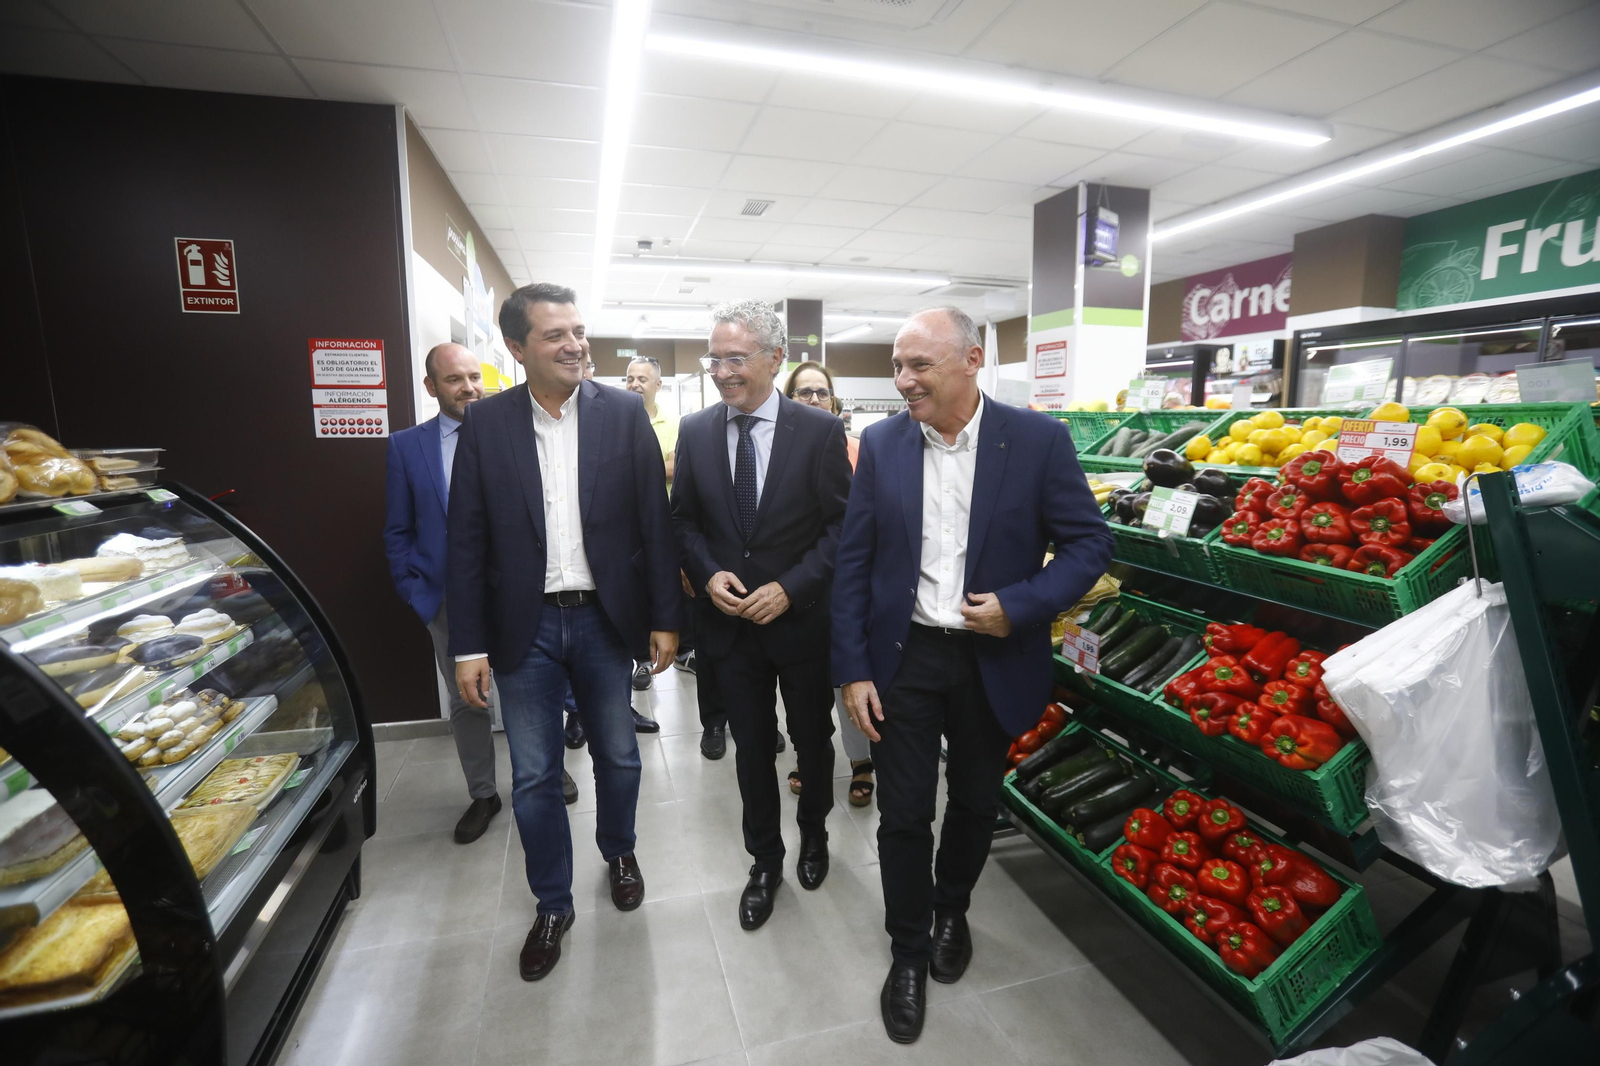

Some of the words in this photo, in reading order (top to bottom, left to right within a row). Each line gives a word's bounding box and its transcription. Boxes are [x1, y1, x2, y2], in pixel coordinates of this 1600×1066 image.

[1480, 216, 1600, 281] Fru
[187, 297, 235, 305] EXTINTOR
[1191, 279, 1292, 325] Carne
[315, 340, 377, 349] INFORMACIÓN
[1343, 420, 1375, 432] OFERTA
[1340, 434, 1366, 444] PRECIO
